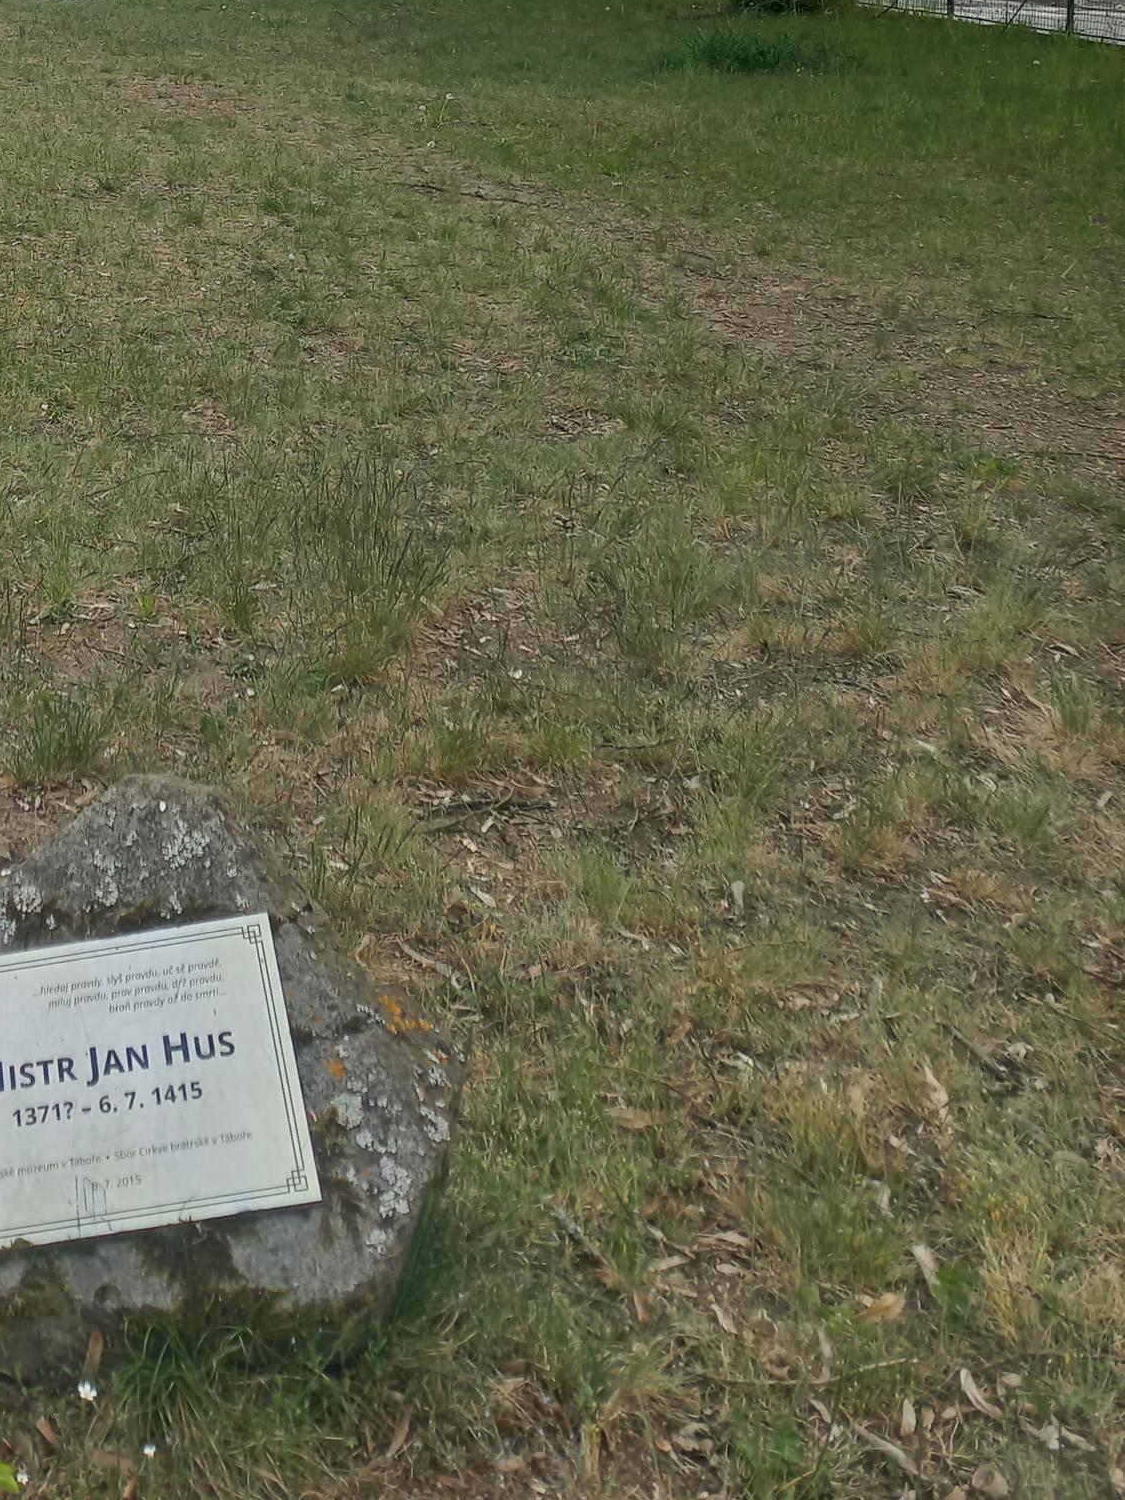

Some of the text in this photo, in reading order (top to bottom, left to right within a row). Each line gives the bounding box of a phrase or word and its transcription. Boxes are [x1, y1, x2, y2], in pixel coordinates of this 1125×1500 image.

[125, 968, 160, 984] pravdu,
[161, 965, 173, 977] uč
[48, 997, 72, 1011] miluj
[111, 988, 133, 1001] prav
[134, 981, 169, 998] pravdu,
[133, 996, 166, 1013] pravdy
[180, 991, 193, 1003] do
[86, 1044, 150, 1088] JAN
[162, 1031, 236, 1066] HUS
[13, 1101, 74, 1128] 1371?
[99, 1095, 118, 1114] 6.
[124, 1091, 144, 1110] 7.
[151, 1081, 203, 1105] 1415
[116, 1174, 142, 1189] 2015
